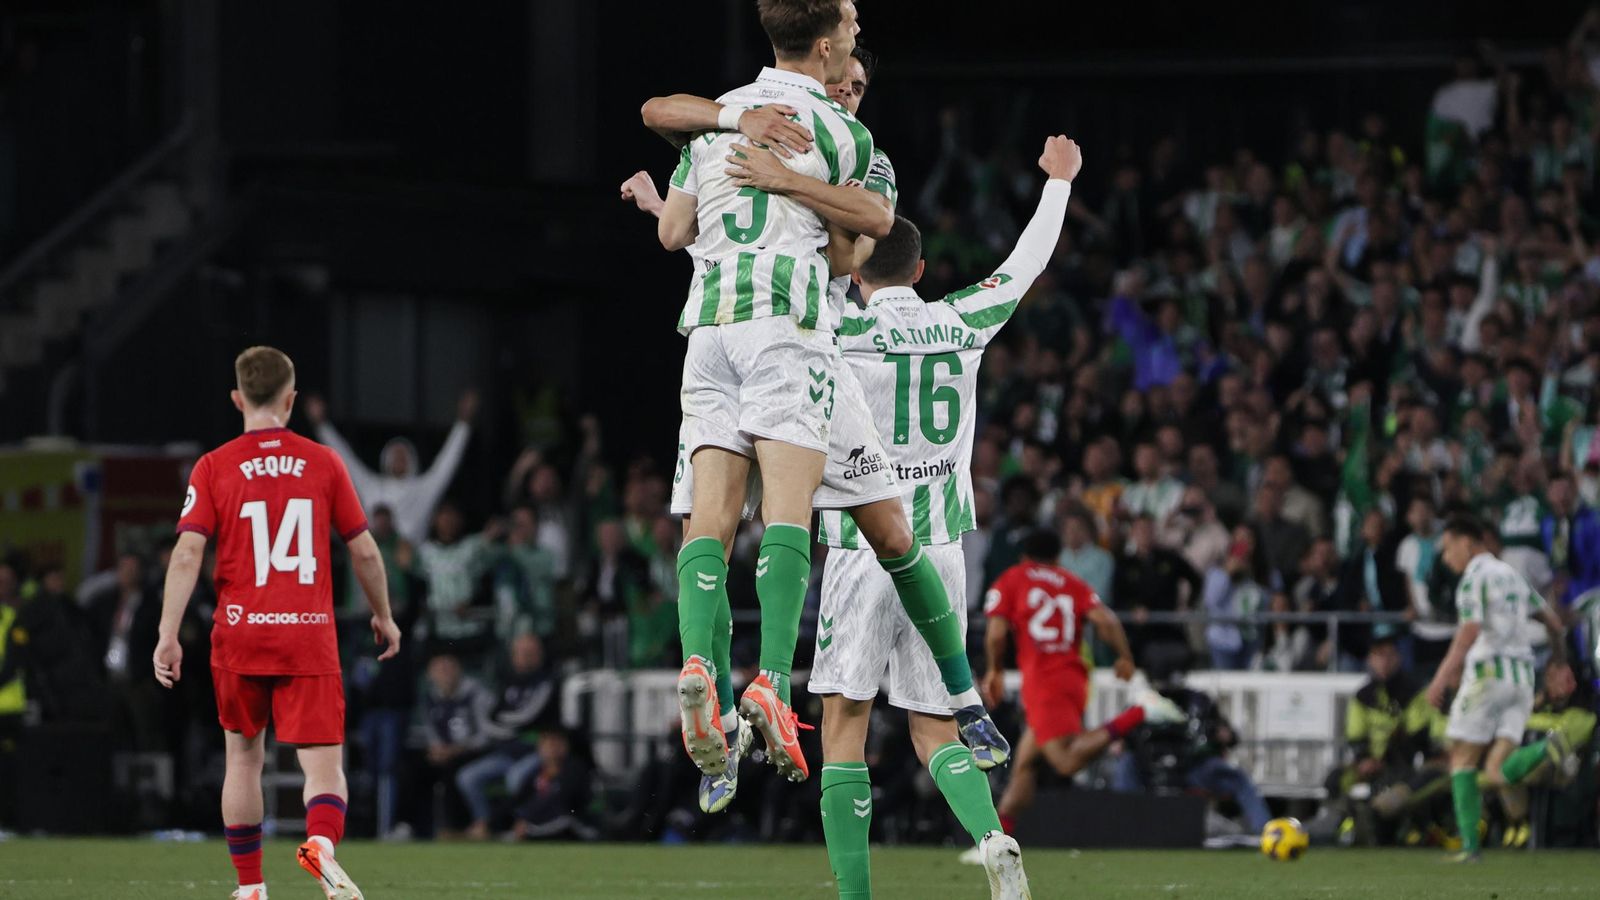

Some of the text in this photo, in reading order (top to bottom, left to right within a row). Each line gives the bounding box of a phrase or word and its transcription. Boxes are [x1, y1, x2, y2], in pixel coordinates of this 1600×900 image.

[872, 324, 976, 353] S.ATIMIRA
[882, 352, 963, 445] 16
[239, 455, 307, 481] PEQUE
[860, 453, 882, 467] AUS
[239, 498, 317, 588] 14
[1027, 586, 1075, 644] 21
